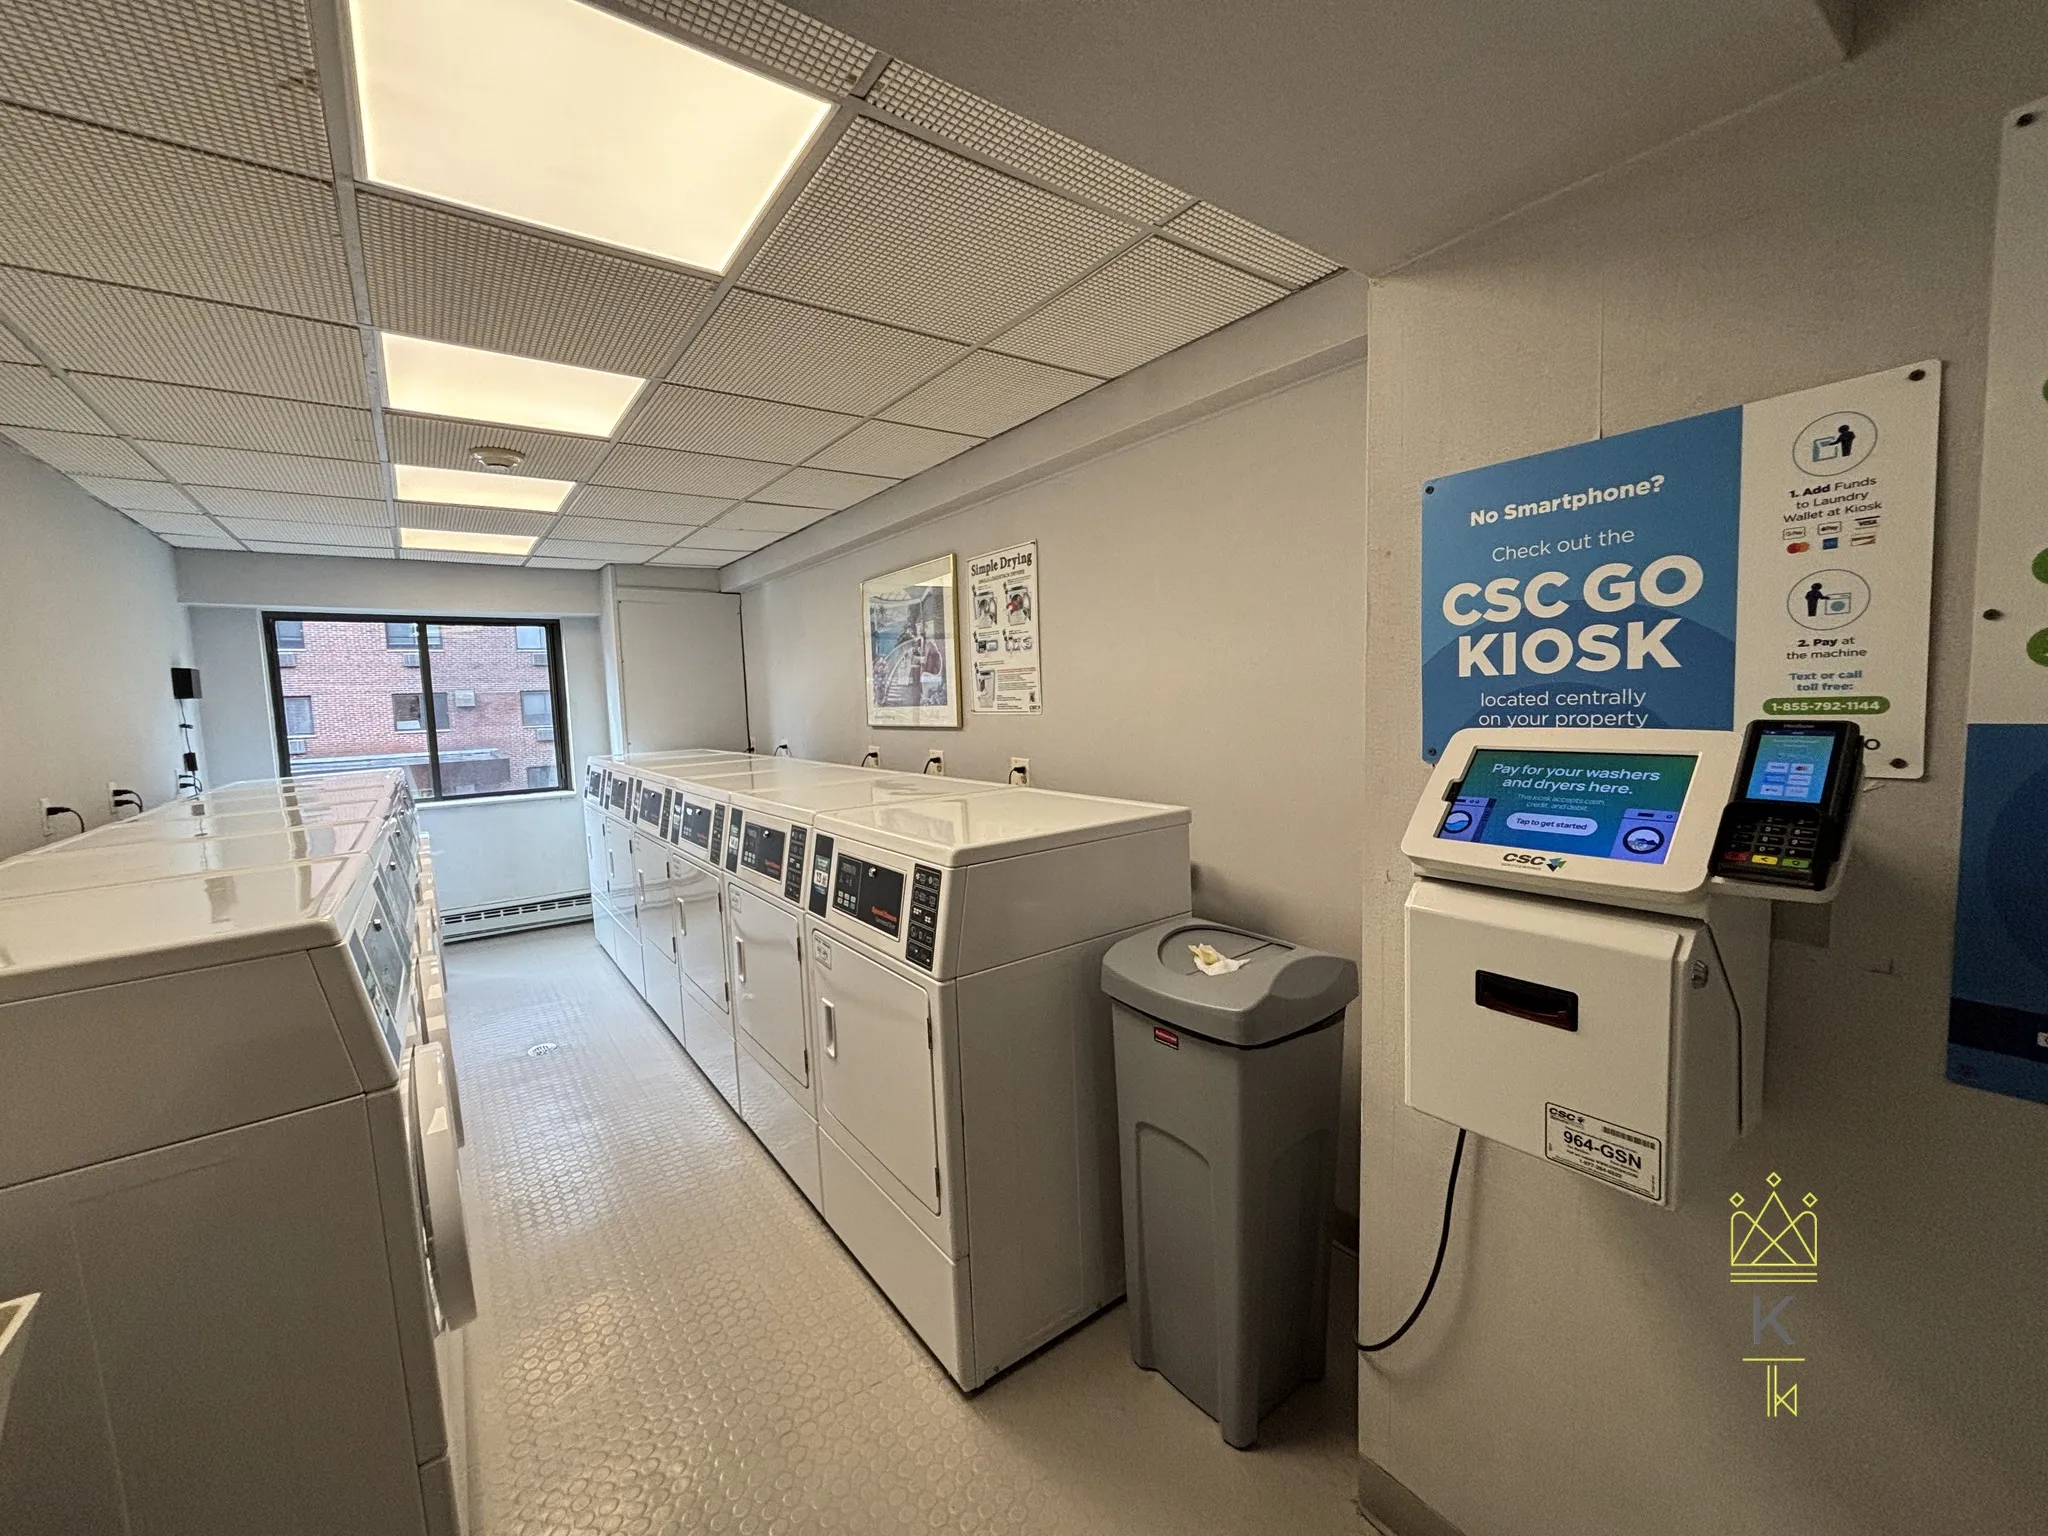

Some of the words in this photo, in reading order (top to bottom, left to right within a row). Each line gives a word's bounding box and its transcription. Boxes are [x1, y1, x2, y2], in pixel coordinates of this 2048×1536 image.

[1789, 490, 1800, 498] 1.
[1802, 484, 1831, 497] Add
[1834, 477, 1877, 491] Funds
[1470, 509, 1499, 527] No
[1504, 474, 1665, 521] Smartphone?
[1796, 501, 1810, 510] to
[1813, 492, 1869, 507] Laundry
[1783, 510, 1823, 523] Wallet
[1827, 507, 1841, 517] at
[1845, 501, 1882, 514] Kiosk
[1492, 539, 1551, 562] Check
[1557, 533, 1592, 553] out
[1600, 529, 1635, 547] the
[971, 559, 998, 577] Simple
[999, 552, 1033, 570] Drying
[1442, 571, 1570, 627] CSC
[1583, 554, 1704, 613] GO
[1458, 618, 1682, 678] KIOSK
[1797, 639, 1810, 648] 2.
[1813, 638, 1838, 647] Pay
[1841, 637, 1855, 645] at
[1786, 651, 1808, 660] the
[1811, 649, 1868, 659] machine
[1788, 672, 1817, 681] Text
[1820, 672, 1835, 680] or
[1838, 670, 1863, 679] call
[1796, 683, 1819, 692] toll
[1822, 682, 1854, 691] free:
[1480, 691, 1549, 707] located
[1555, 688, 1646, 708] centrally
[1771, 701, 1881, 712] 1-855-792-1144
[1478, 713, 1501, 727] on
[1507, 714, 1547, 729] your
[1555, 712, 1649, 729] property
[1492, 763, 1520, 778] Pay
[1522, 764, 1543, 776] for
[1546, 766, 1583, 780] your
[1586, 768, 1661, 781] washers
[1502, 777, 1531, 789] and
[1534, 778, 1585, 793] dryers
[1588, 781, 1634, 795] here.
[1516, 817, 1530, 826] Tap
[1540, 820, 1554, 828] get
[1556, 821, 1588, 831] started
[1503, 852, 1547, 866] CSC
[1549, 1107, 1576, 1121] CSC
[1563, 1130, 1642, 1170] 964-GSN
